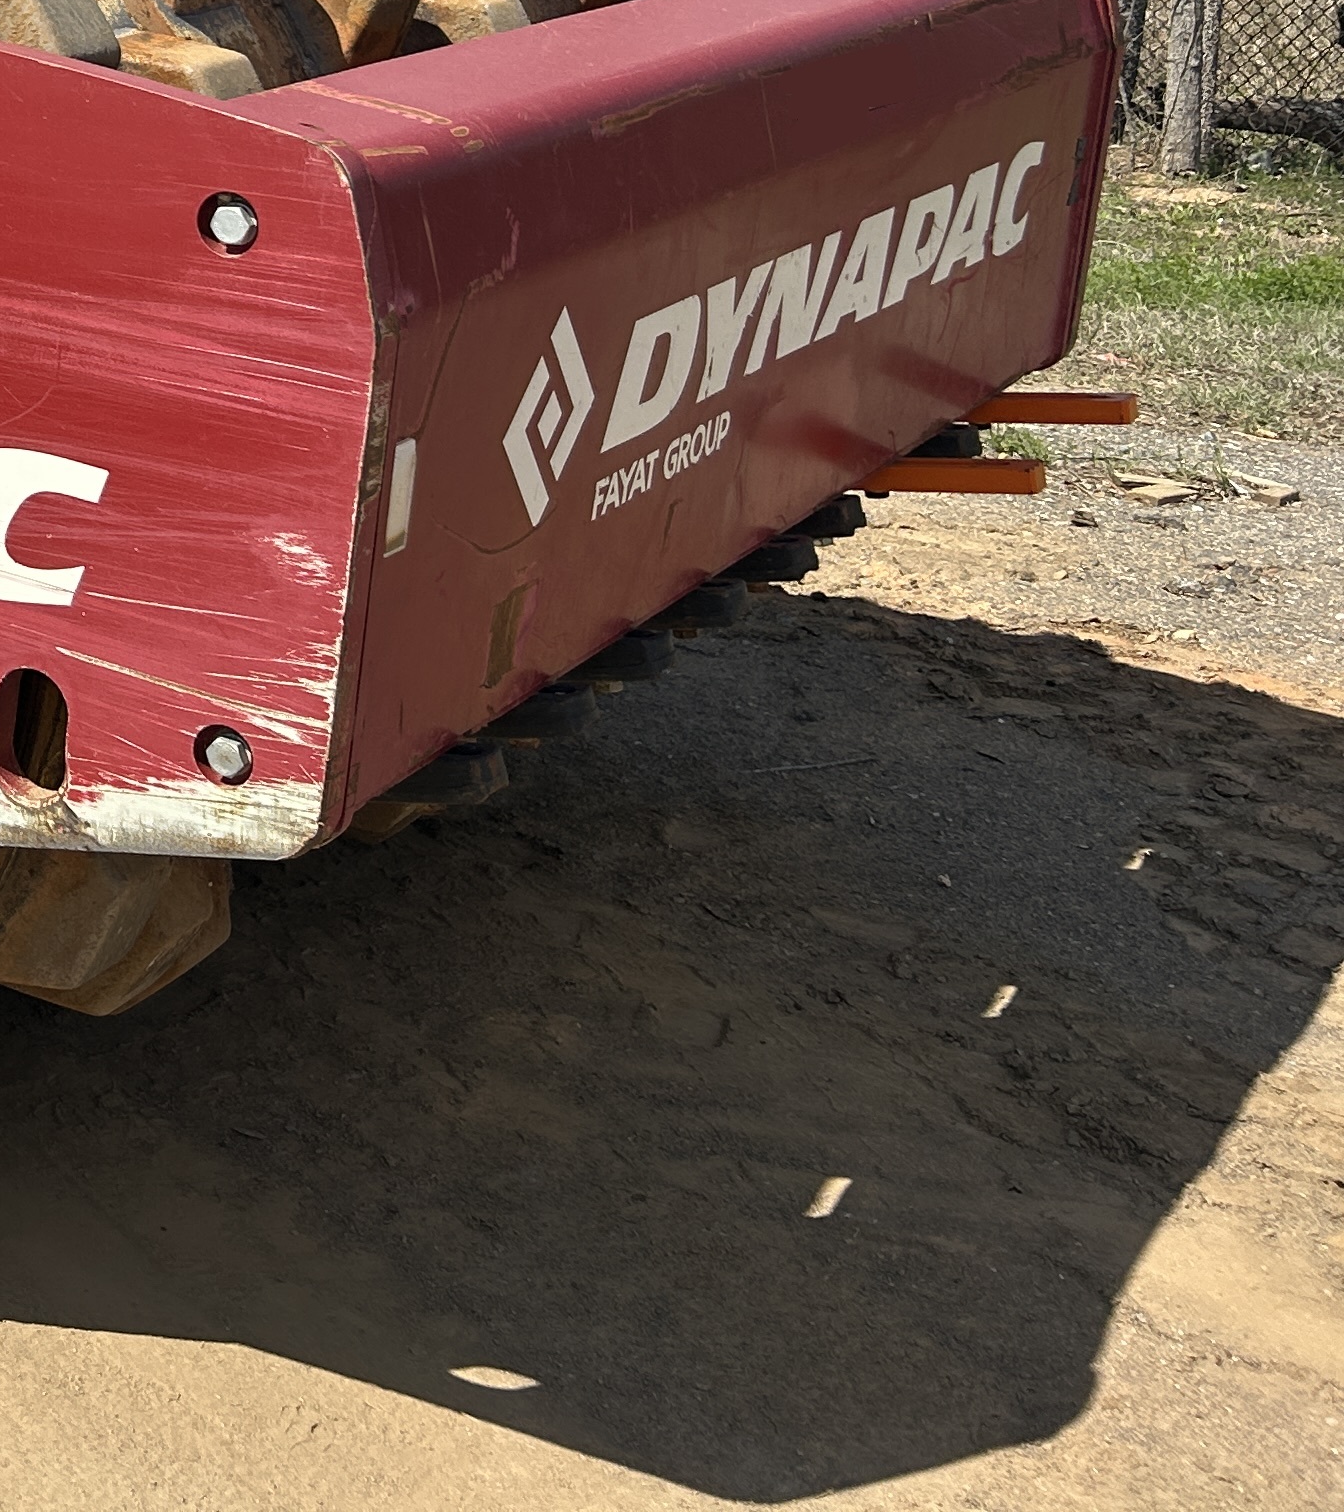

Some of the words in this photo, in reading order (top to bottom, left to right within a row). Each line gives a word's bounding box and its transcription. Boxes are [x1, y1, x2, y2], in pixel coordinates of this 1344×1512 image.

[599, 141, 1045, 454] DYNAPAC
[590, 448, 661, 522] FAYAT
[662, 410, 732, 481] GROUP
